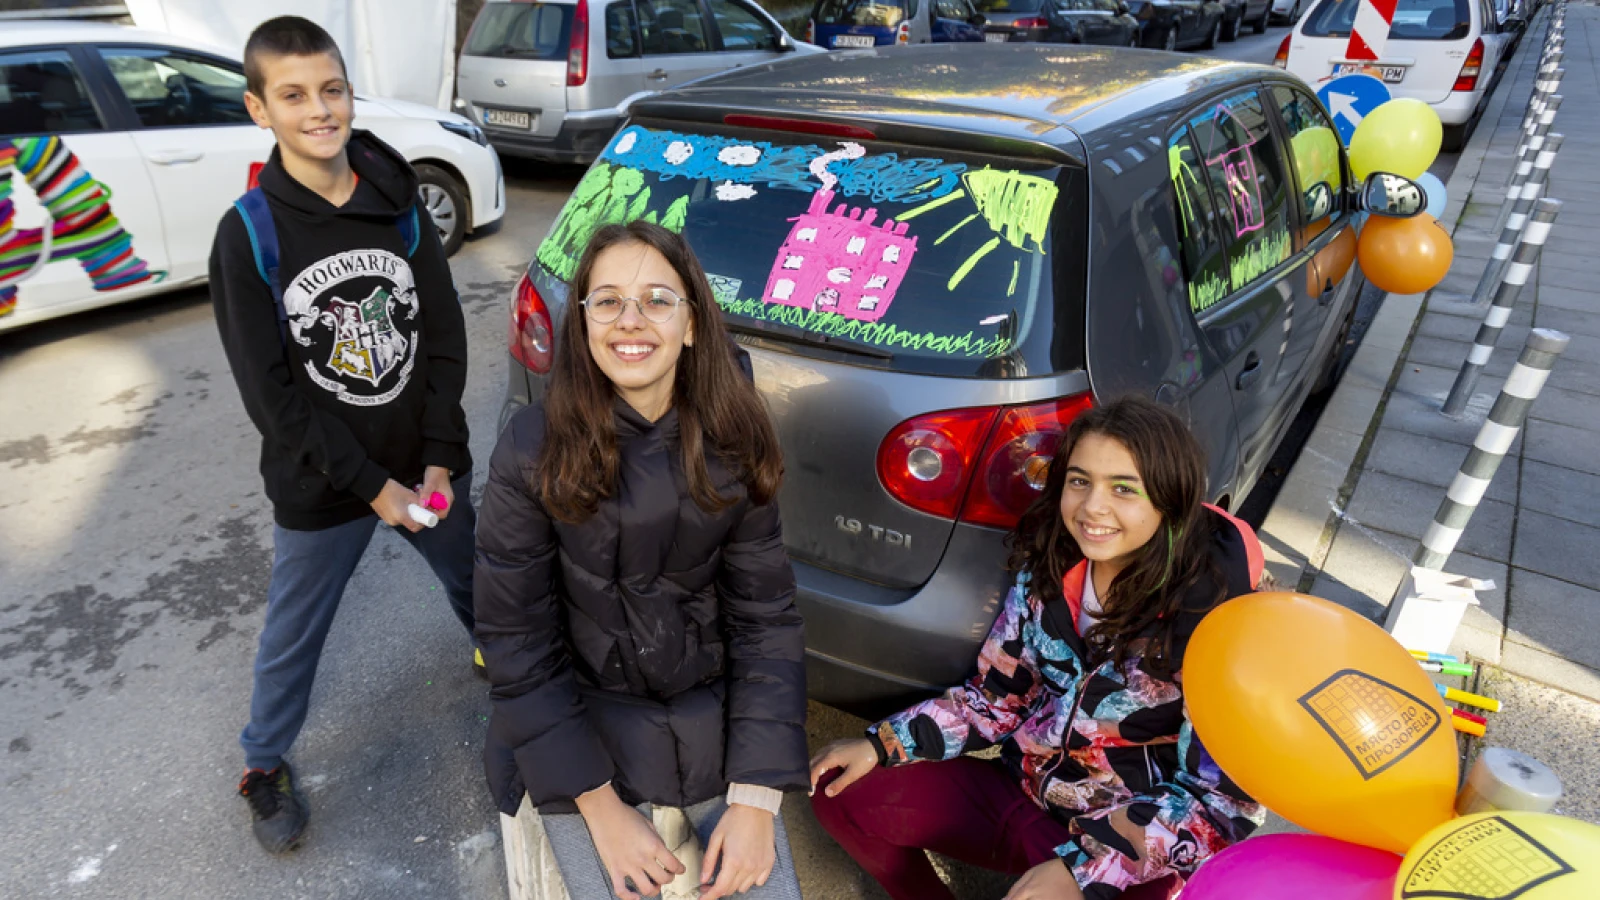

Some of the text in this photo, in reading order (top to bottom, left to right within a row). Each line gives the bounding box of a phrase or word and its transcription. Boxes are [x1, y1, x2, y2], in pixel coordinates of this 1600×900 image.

[297, 254, 396, 295] HOGWARTS
[868, 524, 912, 549] TDI
[1356, 705, 1417, 755] МЯСТО ДО
[1364, 712, 1432, 767] ПРОЗОРЕЦА
